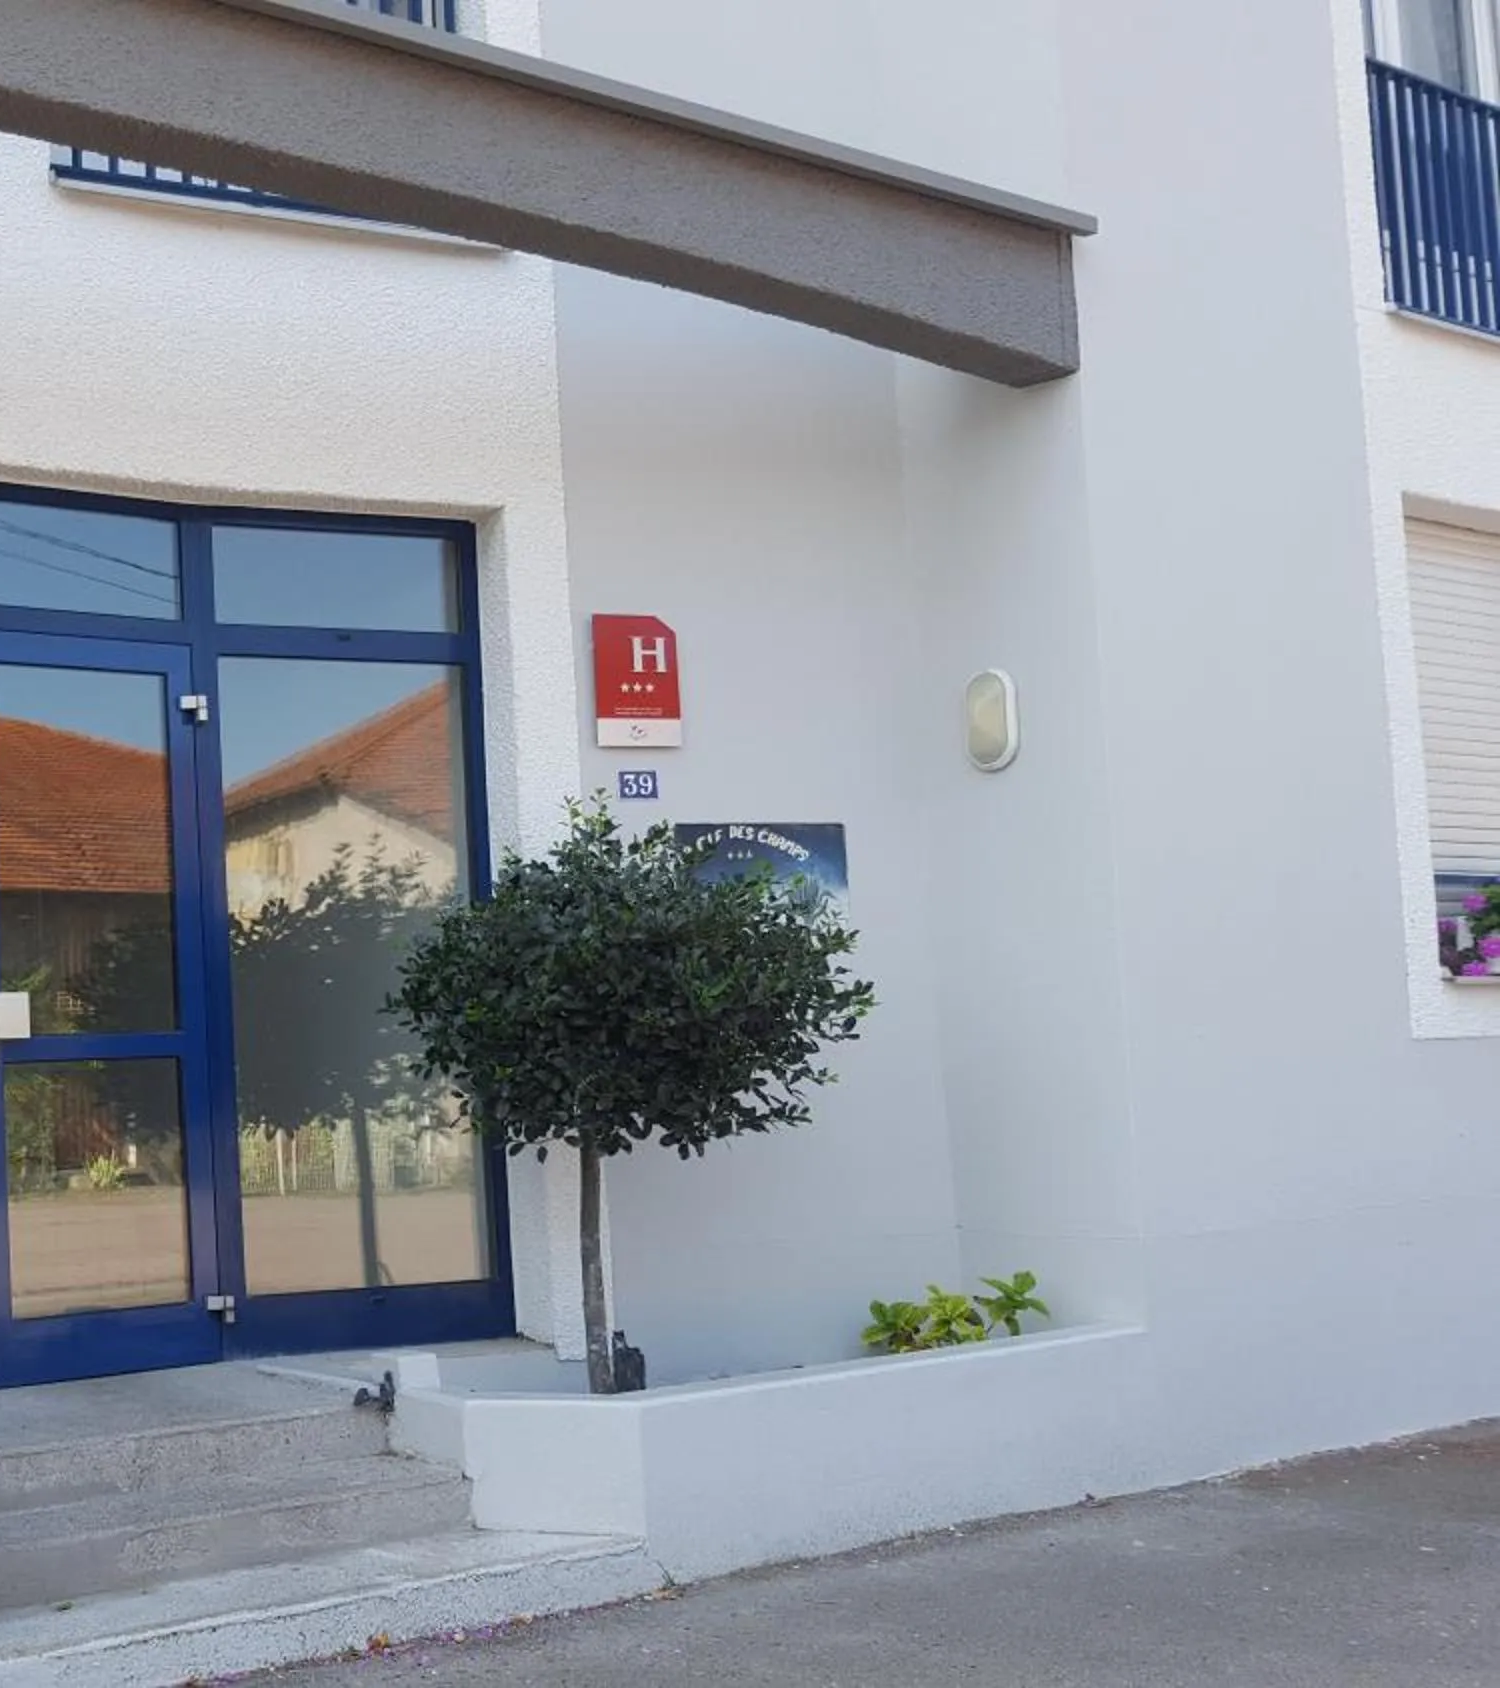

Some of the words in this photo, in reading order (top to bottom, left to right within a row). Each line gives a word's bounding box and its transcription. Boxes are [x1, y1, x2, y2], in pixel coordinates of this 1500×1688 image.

[630, 636, 668, 673] H
[623, 773, 653, 796] 39
[729, 825, 755, 841] DES
[757, 828, 809, 861] CHAMPS
